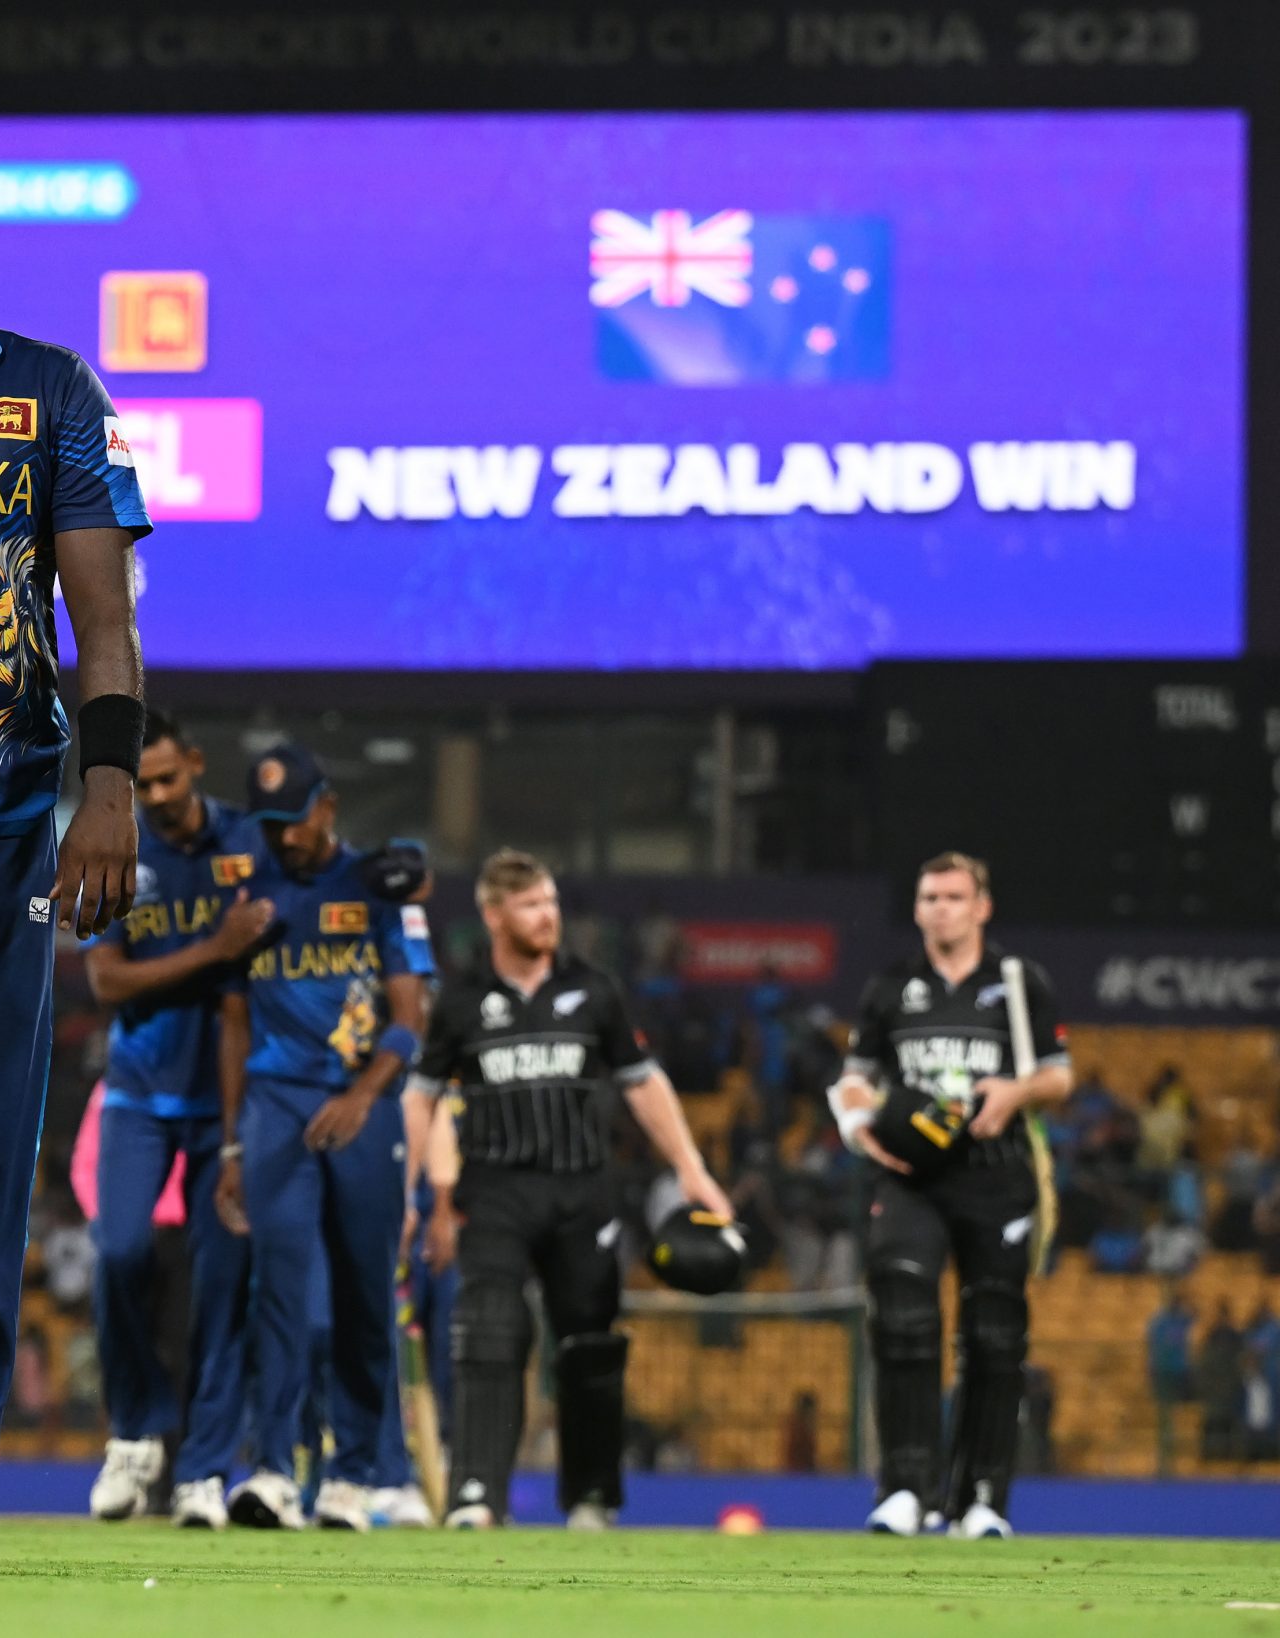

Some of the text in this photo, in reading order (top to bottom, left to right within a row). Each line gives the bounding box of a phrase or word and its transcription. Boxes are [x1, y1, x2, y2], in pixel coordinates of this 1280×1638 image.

[787, 13, 984, 65] INDIA
[1015, 11, 1198, 64] 2023
[325, 440, 1137, 521] NEW ZEALAND WIN
[281, 941, 383, 980] LANKA
[1096, 957, 1280, 1011] #CWC
